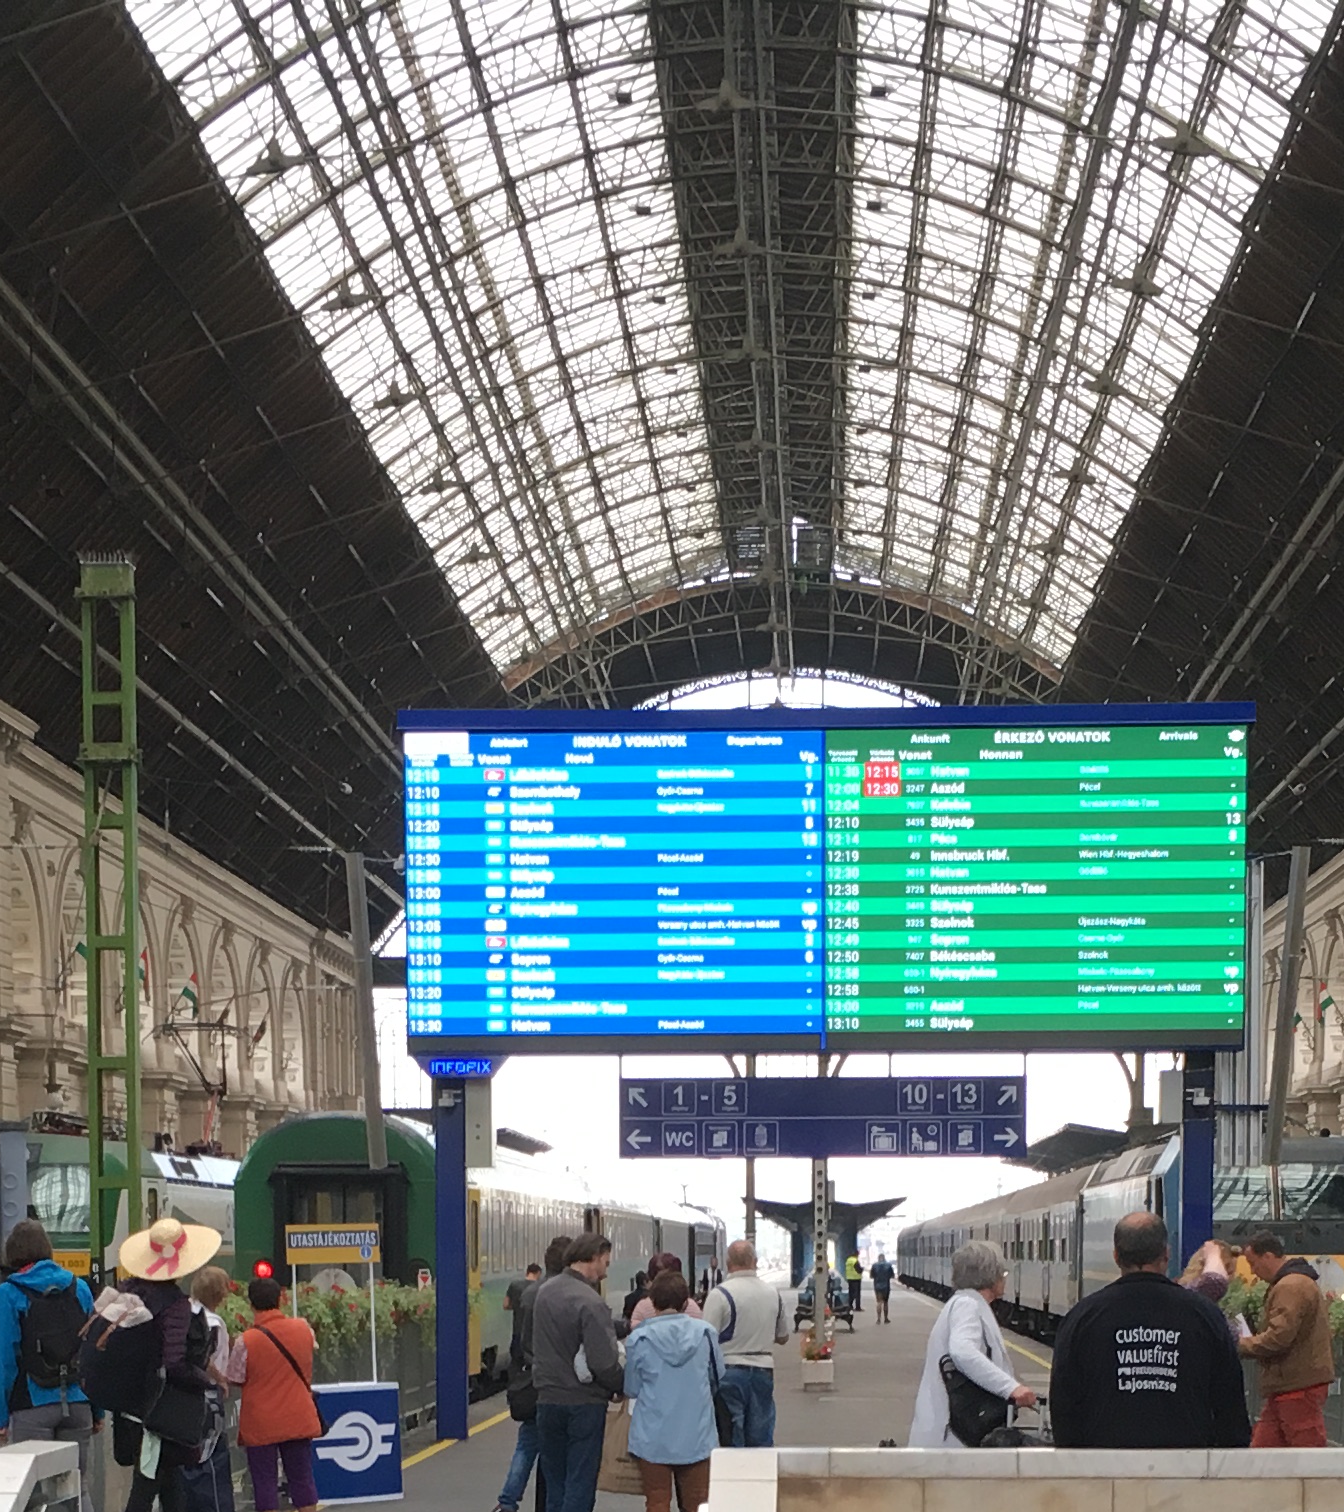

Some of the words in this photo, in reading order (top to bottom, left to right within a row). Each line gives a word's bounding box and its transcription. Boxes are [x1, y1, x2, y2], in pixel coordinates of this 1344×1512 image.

[574, 735, 621, 747] INDULÓ
[625, 735, 686, 747] VONATOK
[911, 734, 950, 743] Ankunft
[994, 730, 1045, 743] ÉRKEZŐ
[1048, 731, 1110, 742] VONATOK
[1159, 732, 1198, 740] Arrivals
[899, 751, 932, 760] Vonat
[980, 750, 1022, 759] Honnan
[1224, 747, 1243, 758] Vg.
[866, 765, 898, 778] 12:15
[408, 787, 439, 799] 12:10
[867, 783, 898, 795] 12:30
[906, 784, 924, 793] 3247
[828, 800, 859, 811] 12:04
[828, 817, 859, 828] 12:10
[1226, 812, 1241, 824] 13
[408, 820, 439, 832] 12:20
[828, 833, 859, 845] 12:14
[408, 854, 440, 865] 12:30
[828, 850, 859, 862] 12:19
[931, 850, 984, 860] Innsbruck
[987, 849, 1009, 860] Hbf.
[409, 887, 440, 899] 13:00
[828, 884, 859, 895] 12:38
[828, 918, 859, 929] 12:45
[409, 954, 441, 966] 13:10
[828, 951, 859, 962] 12:50
[906, 952, 924, 960] 7407
[410, 987, 441, 999] 13:20
[828, 984, 859, 995] 12:58
[828, 1018, 859, 1029] 13:10
[672, 1085, 685, 1108] 1
[723, 1085, 737, 1108] 5
[902, 1084, 928, 1104] 10
[952, 1084, 978, 1104] 13
[666, 1132, 694, 1146] WC
[290, 1230, 377, 1248] UTASTÁJÉKOZTATÁS
[1115, 1326, 1181, 1345] customer
